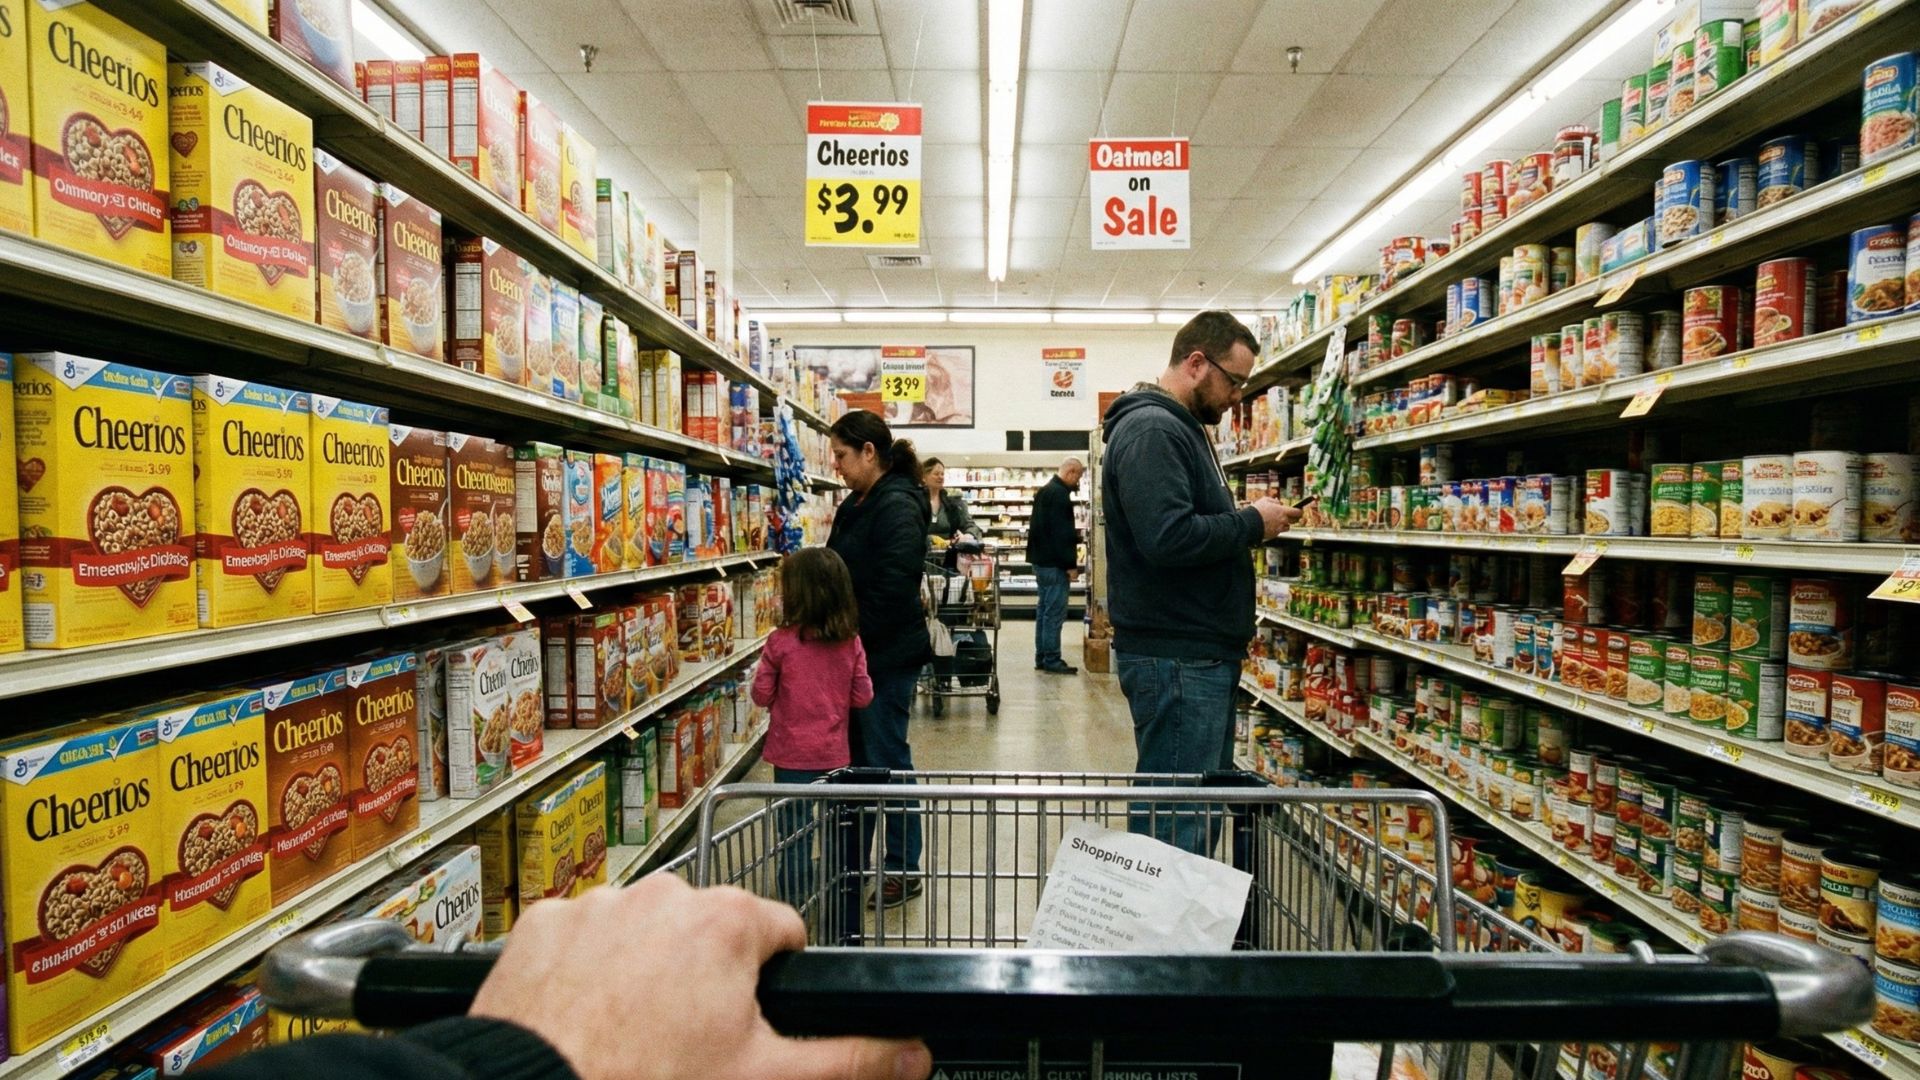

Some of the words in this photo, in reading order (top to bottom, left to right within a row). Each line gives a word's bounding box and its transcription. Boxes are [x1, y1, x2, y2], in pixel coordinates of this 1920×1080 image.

[47, 20, 160, 110] Cheerios
[223, 103, 308, 173] Cheerios
[817, 139, 909, 167] Cheerios
[1096, 142, 1182, 169] Oatmeal
[1127, 176, 1151, 193] on
[325, 187, 378, 241] Cheerios
[817, 182, 910, 234] $3.99
[1103, 195, 1179, 237] Sale
[393, 219, 440, 266] Cheerios
[885, 376, 920, 397] $3.99
[74, 404, 186, 456] Cheerios
[222, 419, 305, 462] Cheerios
[322, 431, 385, 469] Cheerios
[396, 456, 446, 489] Cheerios
[356, 684, 415, 728] Cheerios
[272, 707, 344, 756] Cheerios
[169, 741, 261, 793] Cheerios
[25, 776, 151, 843] Cheerios
[1070, 836, 1134, 871] Shopping
[1135, 858, 1163, 879] List
